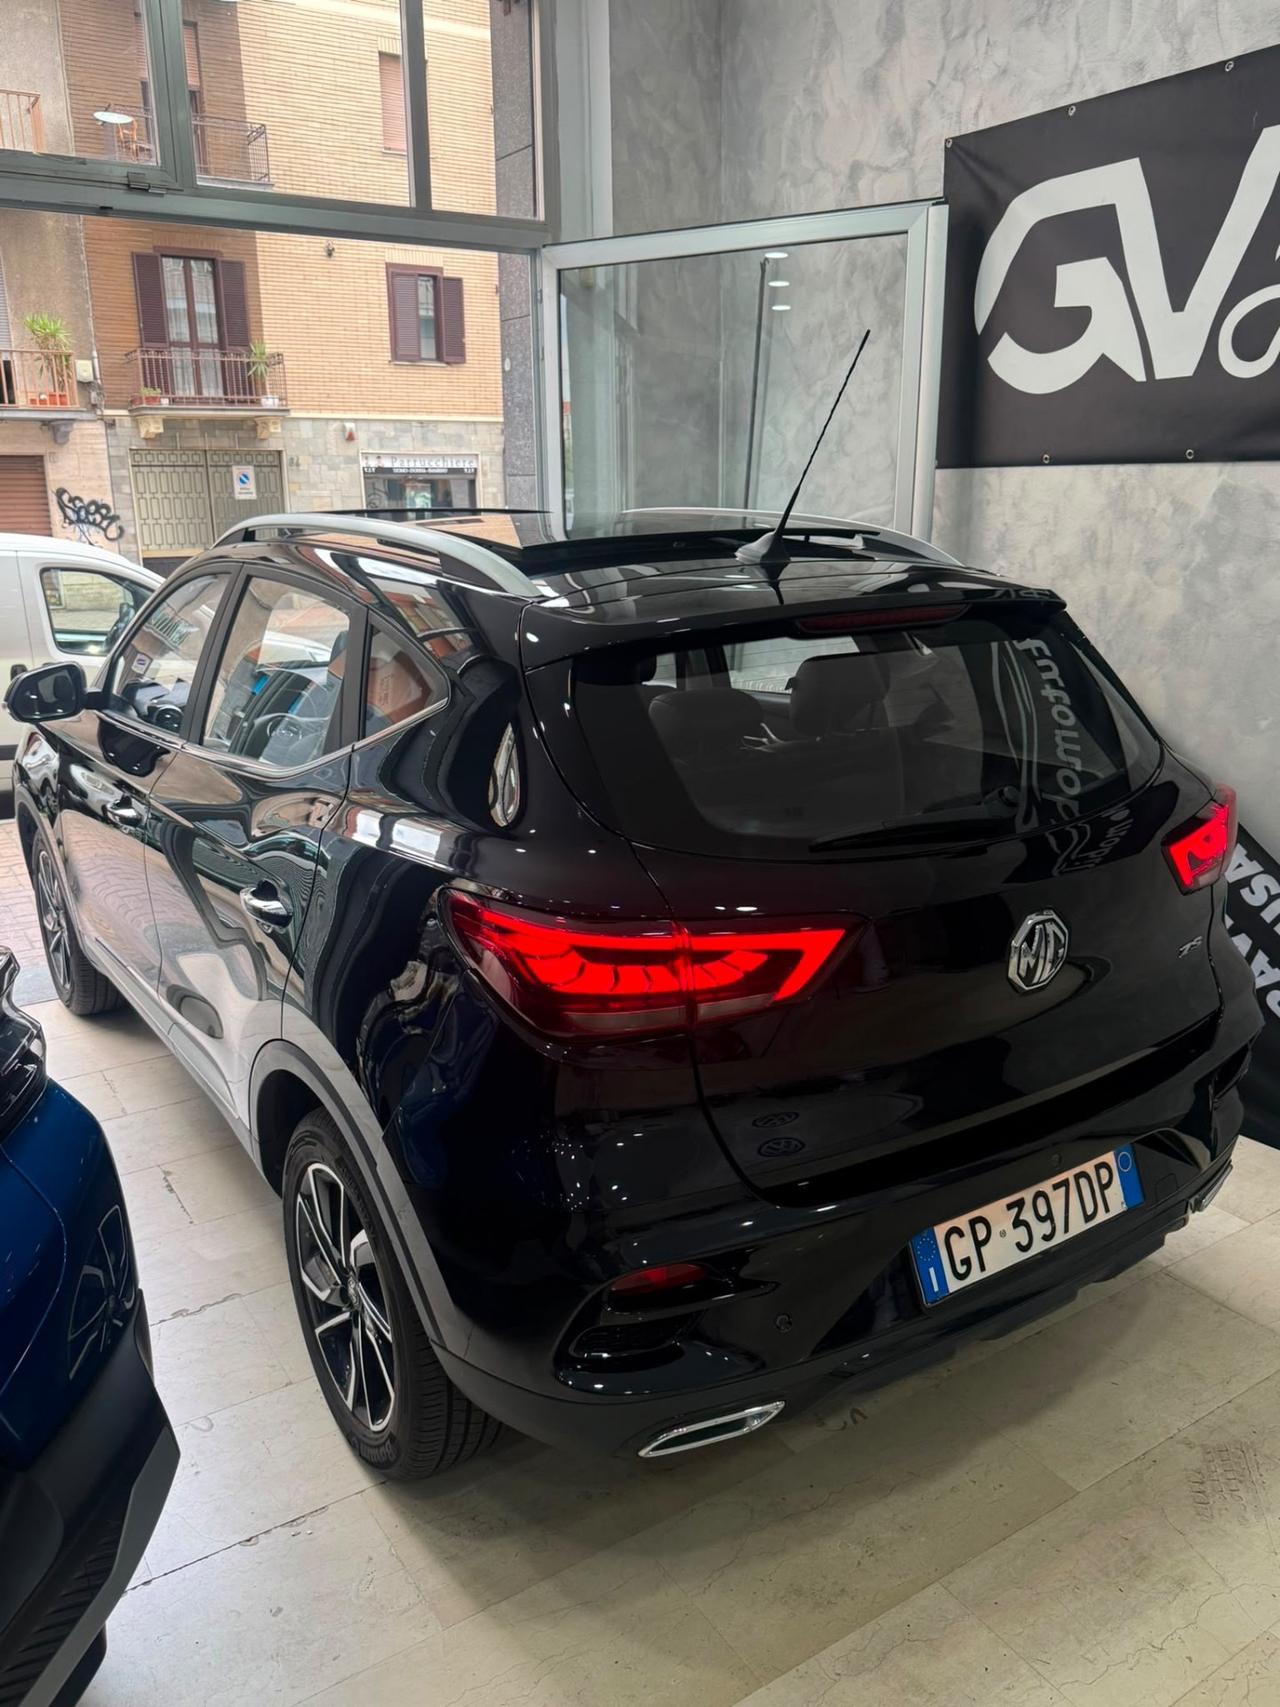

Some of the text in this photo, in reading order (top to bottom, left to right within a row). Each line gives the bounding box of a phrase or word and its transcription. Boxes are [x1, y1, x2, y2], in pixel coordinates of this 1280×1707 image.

[391, 455, 475, 467] Parrucchiere
[1014, 914, 1067, 987] MG
[944, 1215, 992, 1281] GP
[1006, 1161, 1114, 1253] 397DP
